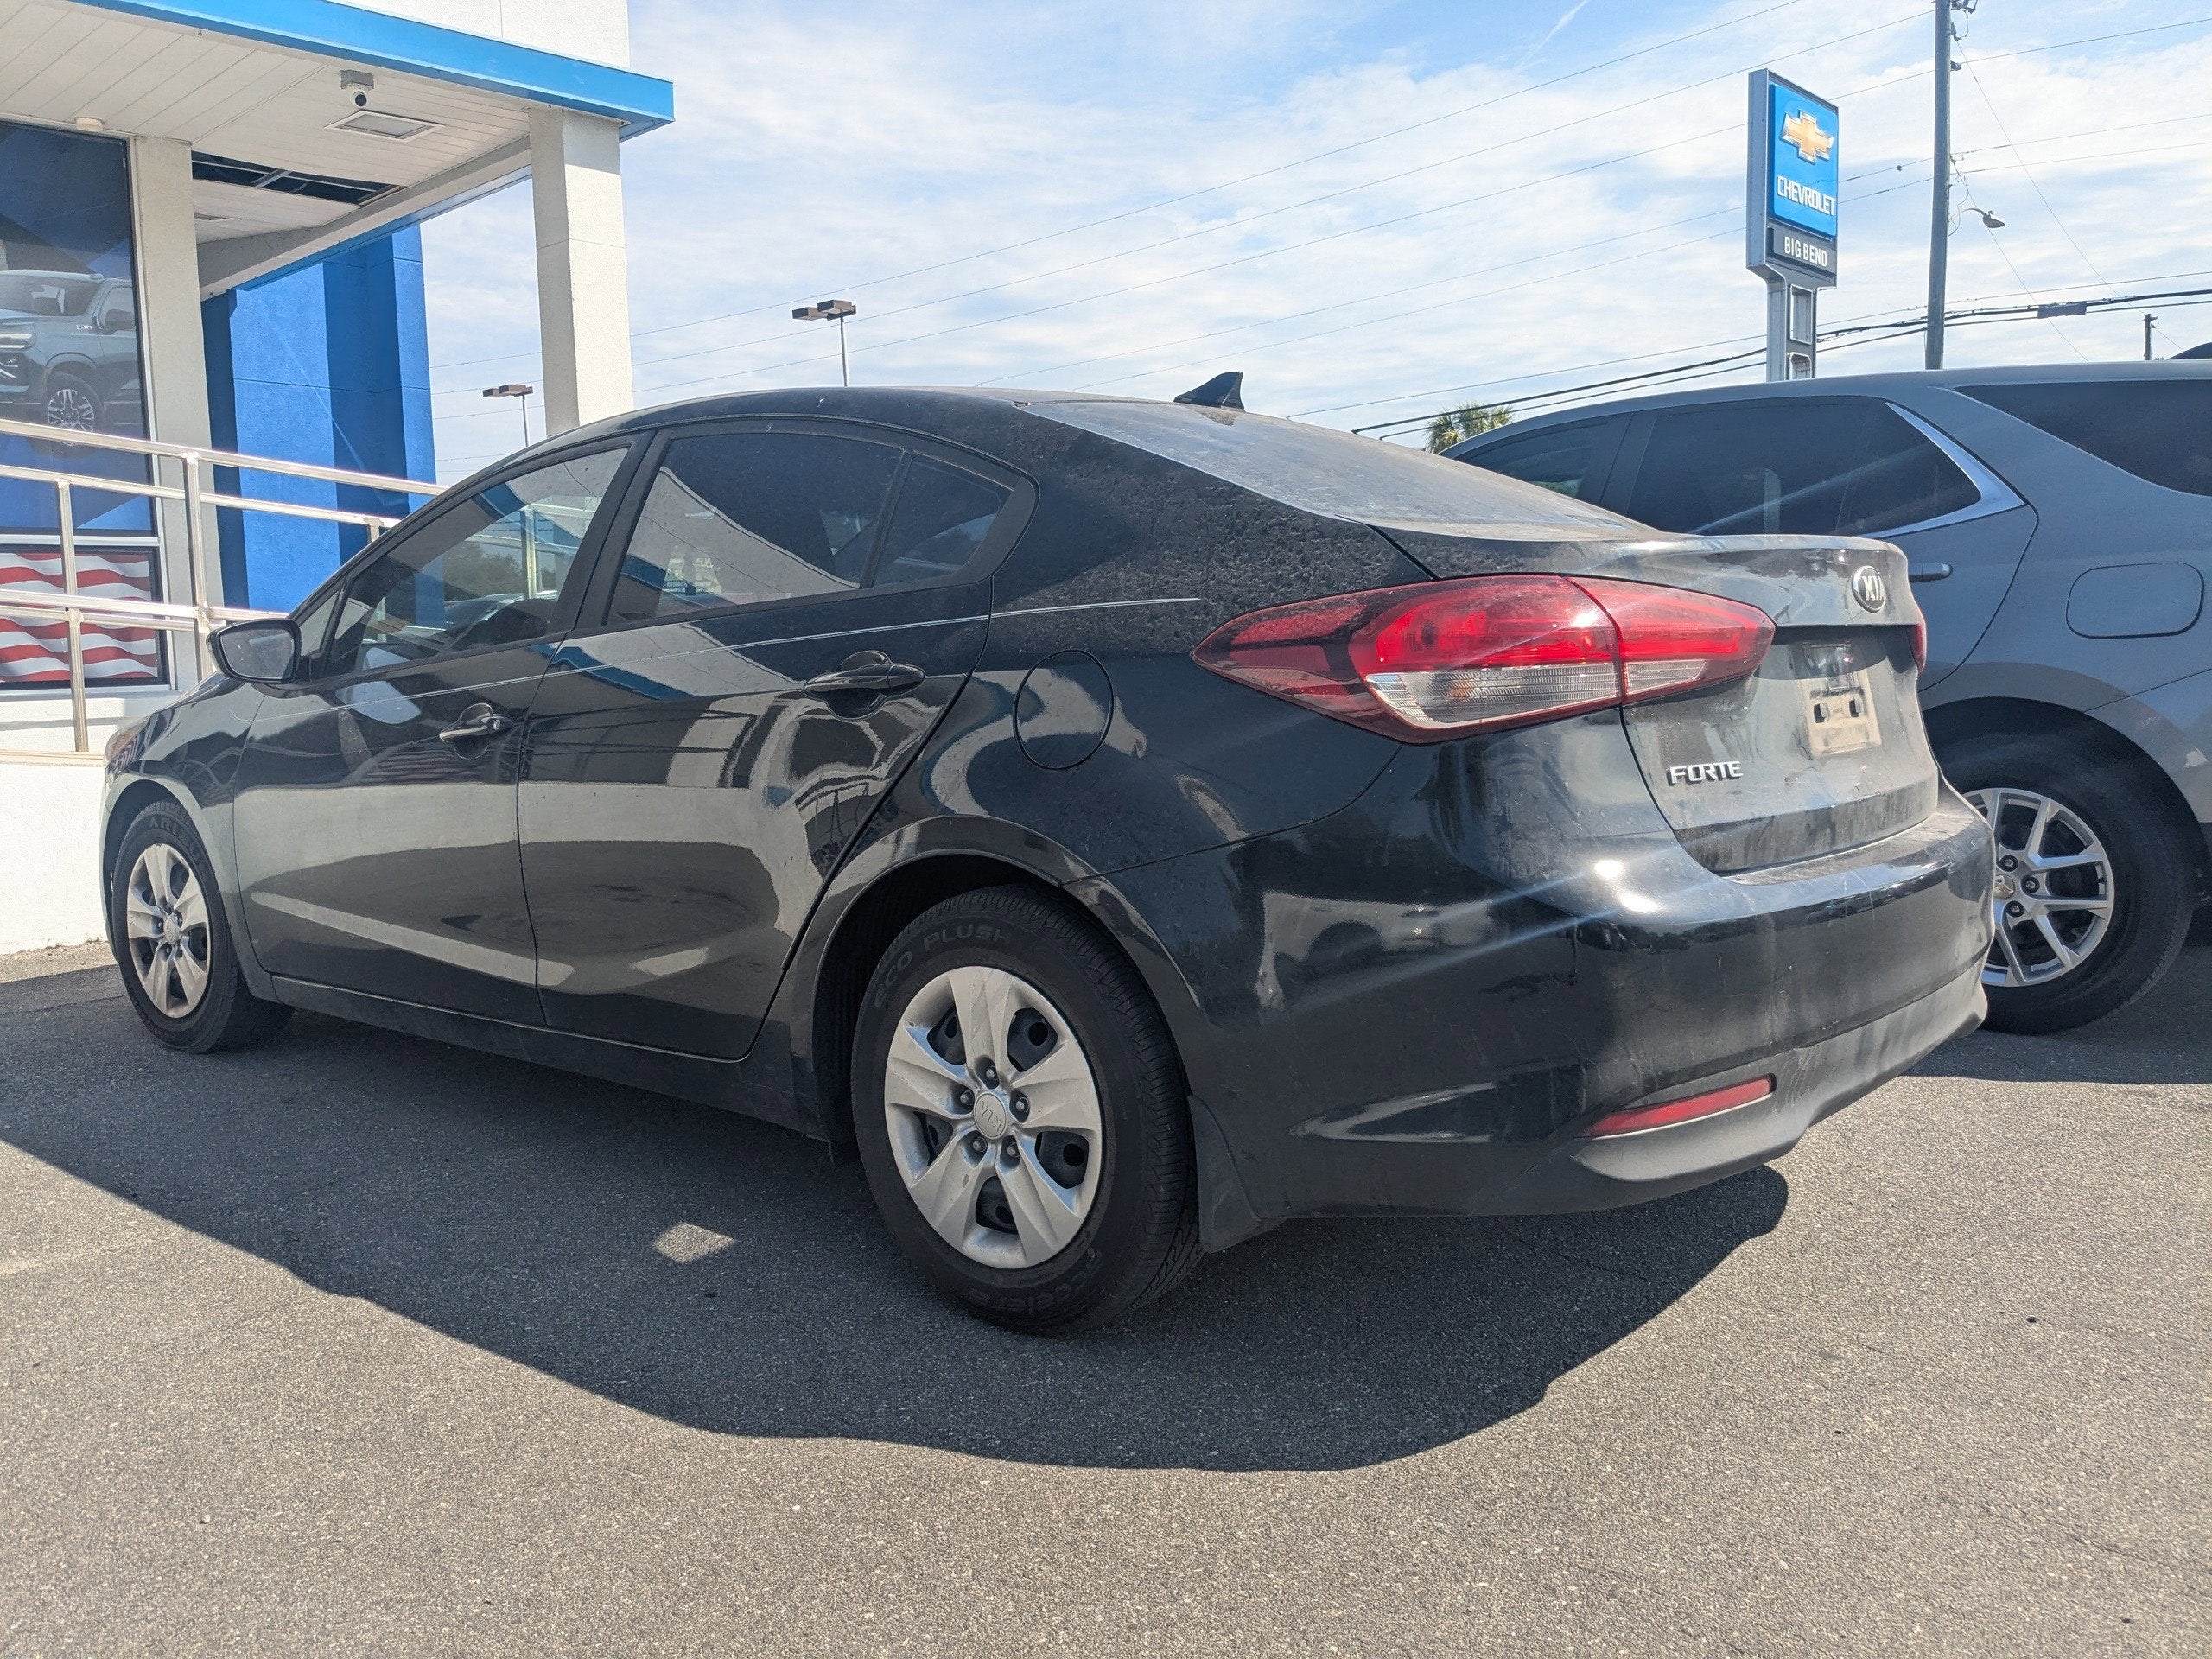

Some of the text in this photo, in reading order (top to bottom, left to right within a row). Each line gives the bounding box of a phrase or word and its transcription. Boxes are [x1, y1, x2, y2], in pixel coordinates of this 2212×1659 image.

[1777, 175, 1836, 216] CHEVROLET
[1784, 236, 1827, 267] BIG BEND
[1860, 575, 1885, 601] KIA
[1668, 760, 1744, 785] FORTE
[874, 925, 1012, 1008] ECO PLUSH
